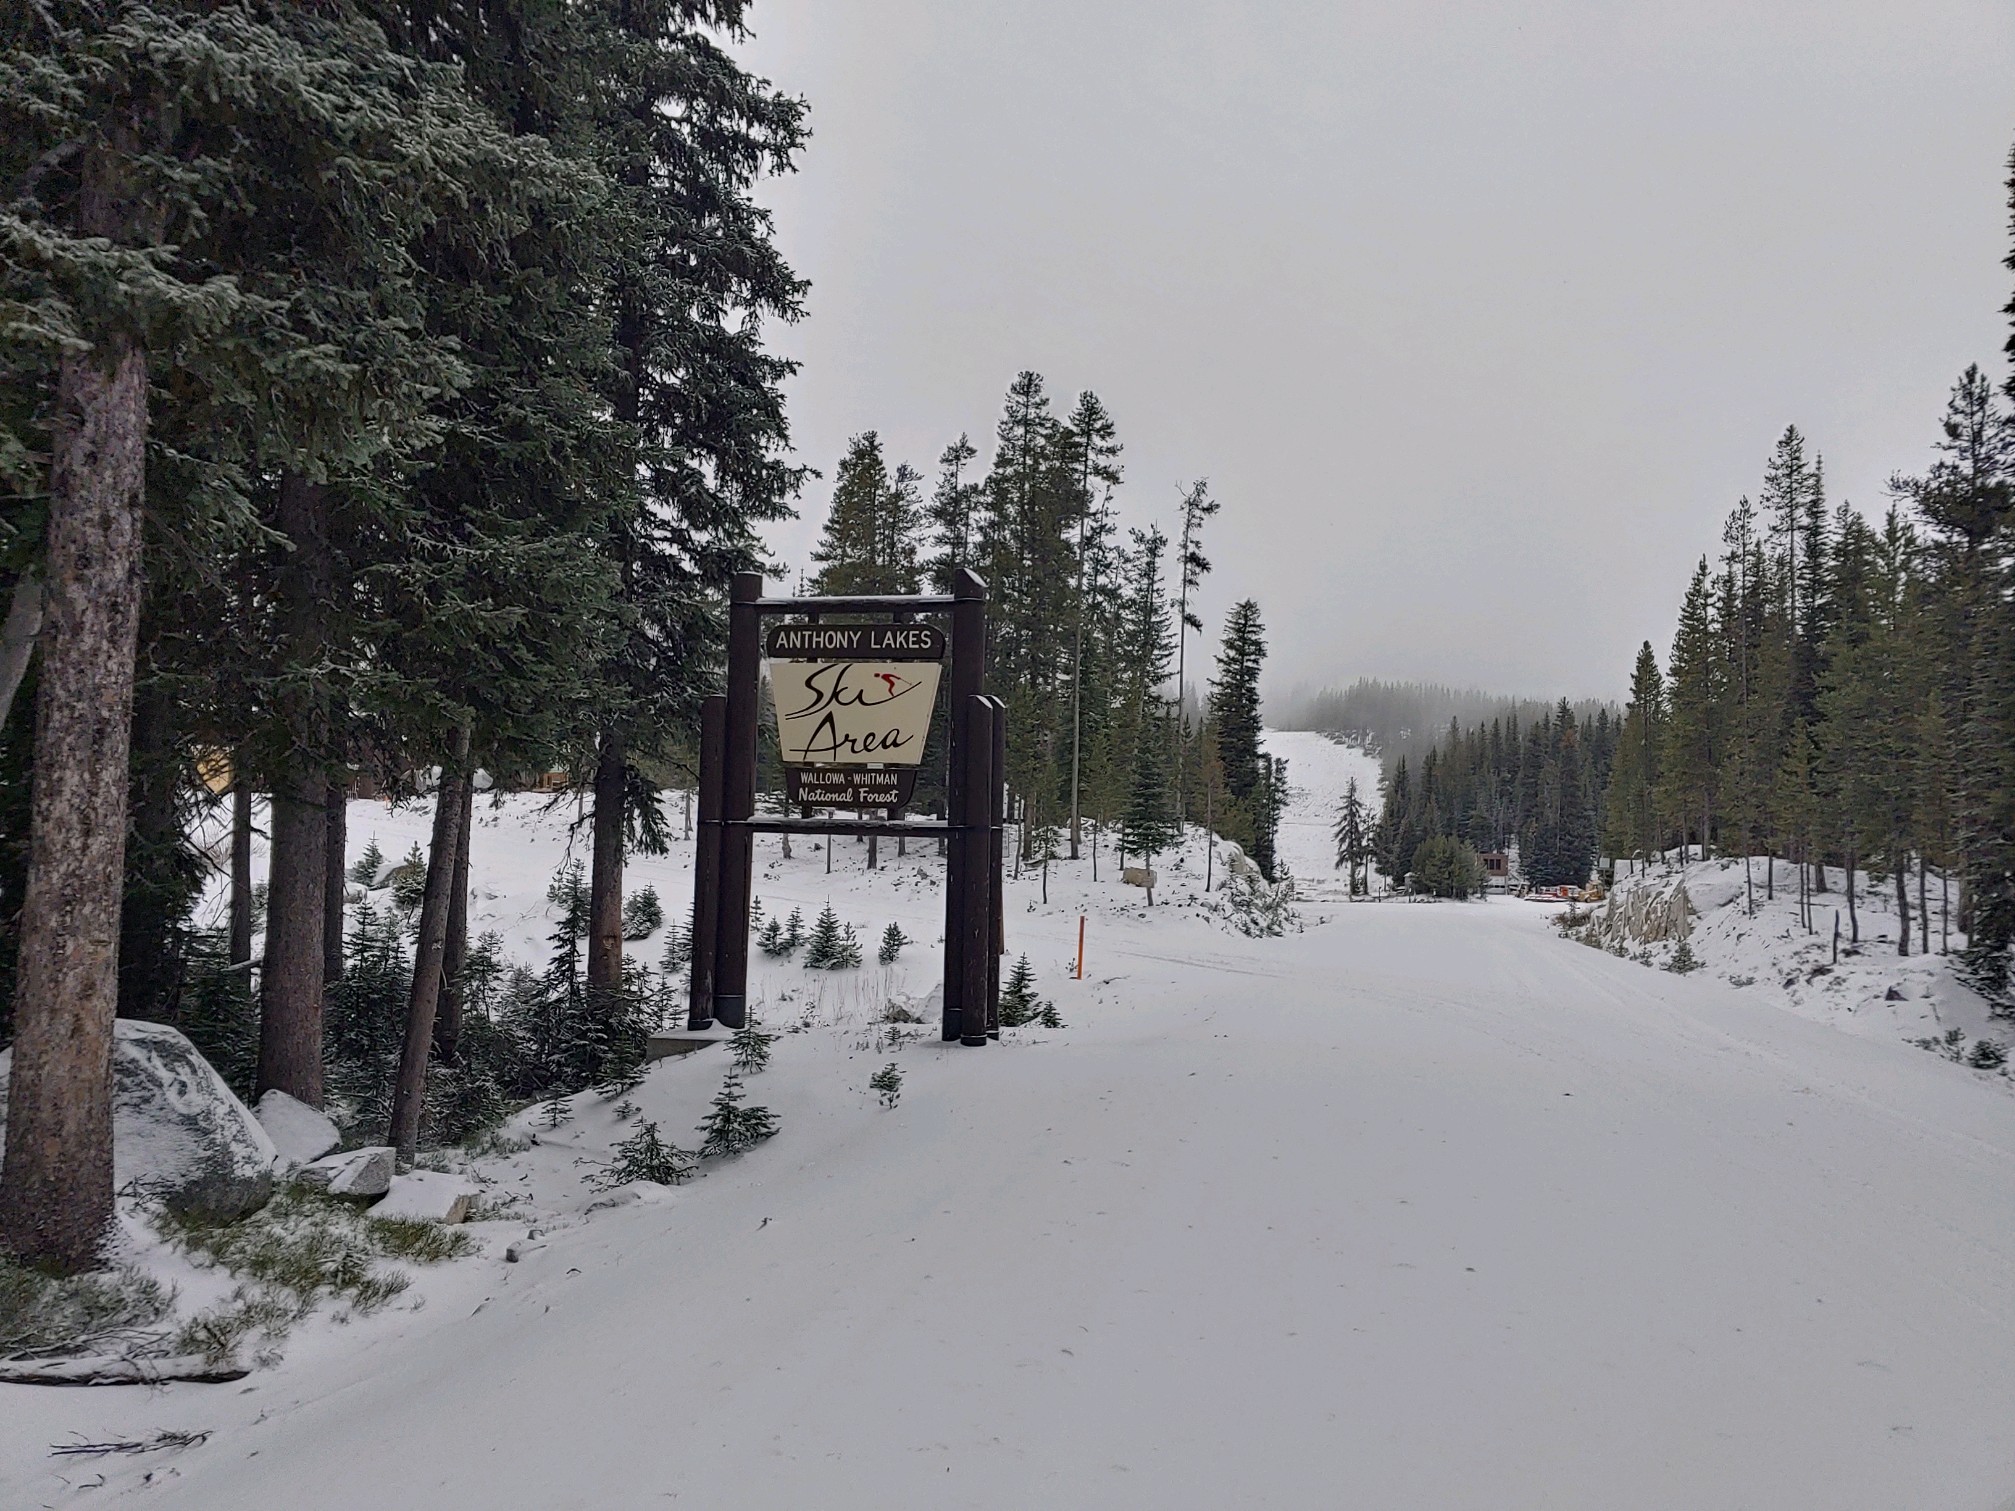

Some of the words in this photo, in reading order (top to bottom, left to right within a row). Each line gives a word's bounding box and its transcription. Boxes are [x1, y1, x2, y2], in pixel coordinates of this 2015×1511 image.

[776, 630, 862, 649] ANTHONY
[870, 630, 932, 649] LAKES
[785, 663, 922, 719] Ski
[789, 711, 914, 761] Area
[800, 772, 845, 785] WALLOWA
[853, 773, 898, 786] WHITMAN
[798, 787, 853, 802] National
[859, 787, 899, 803] Forest
